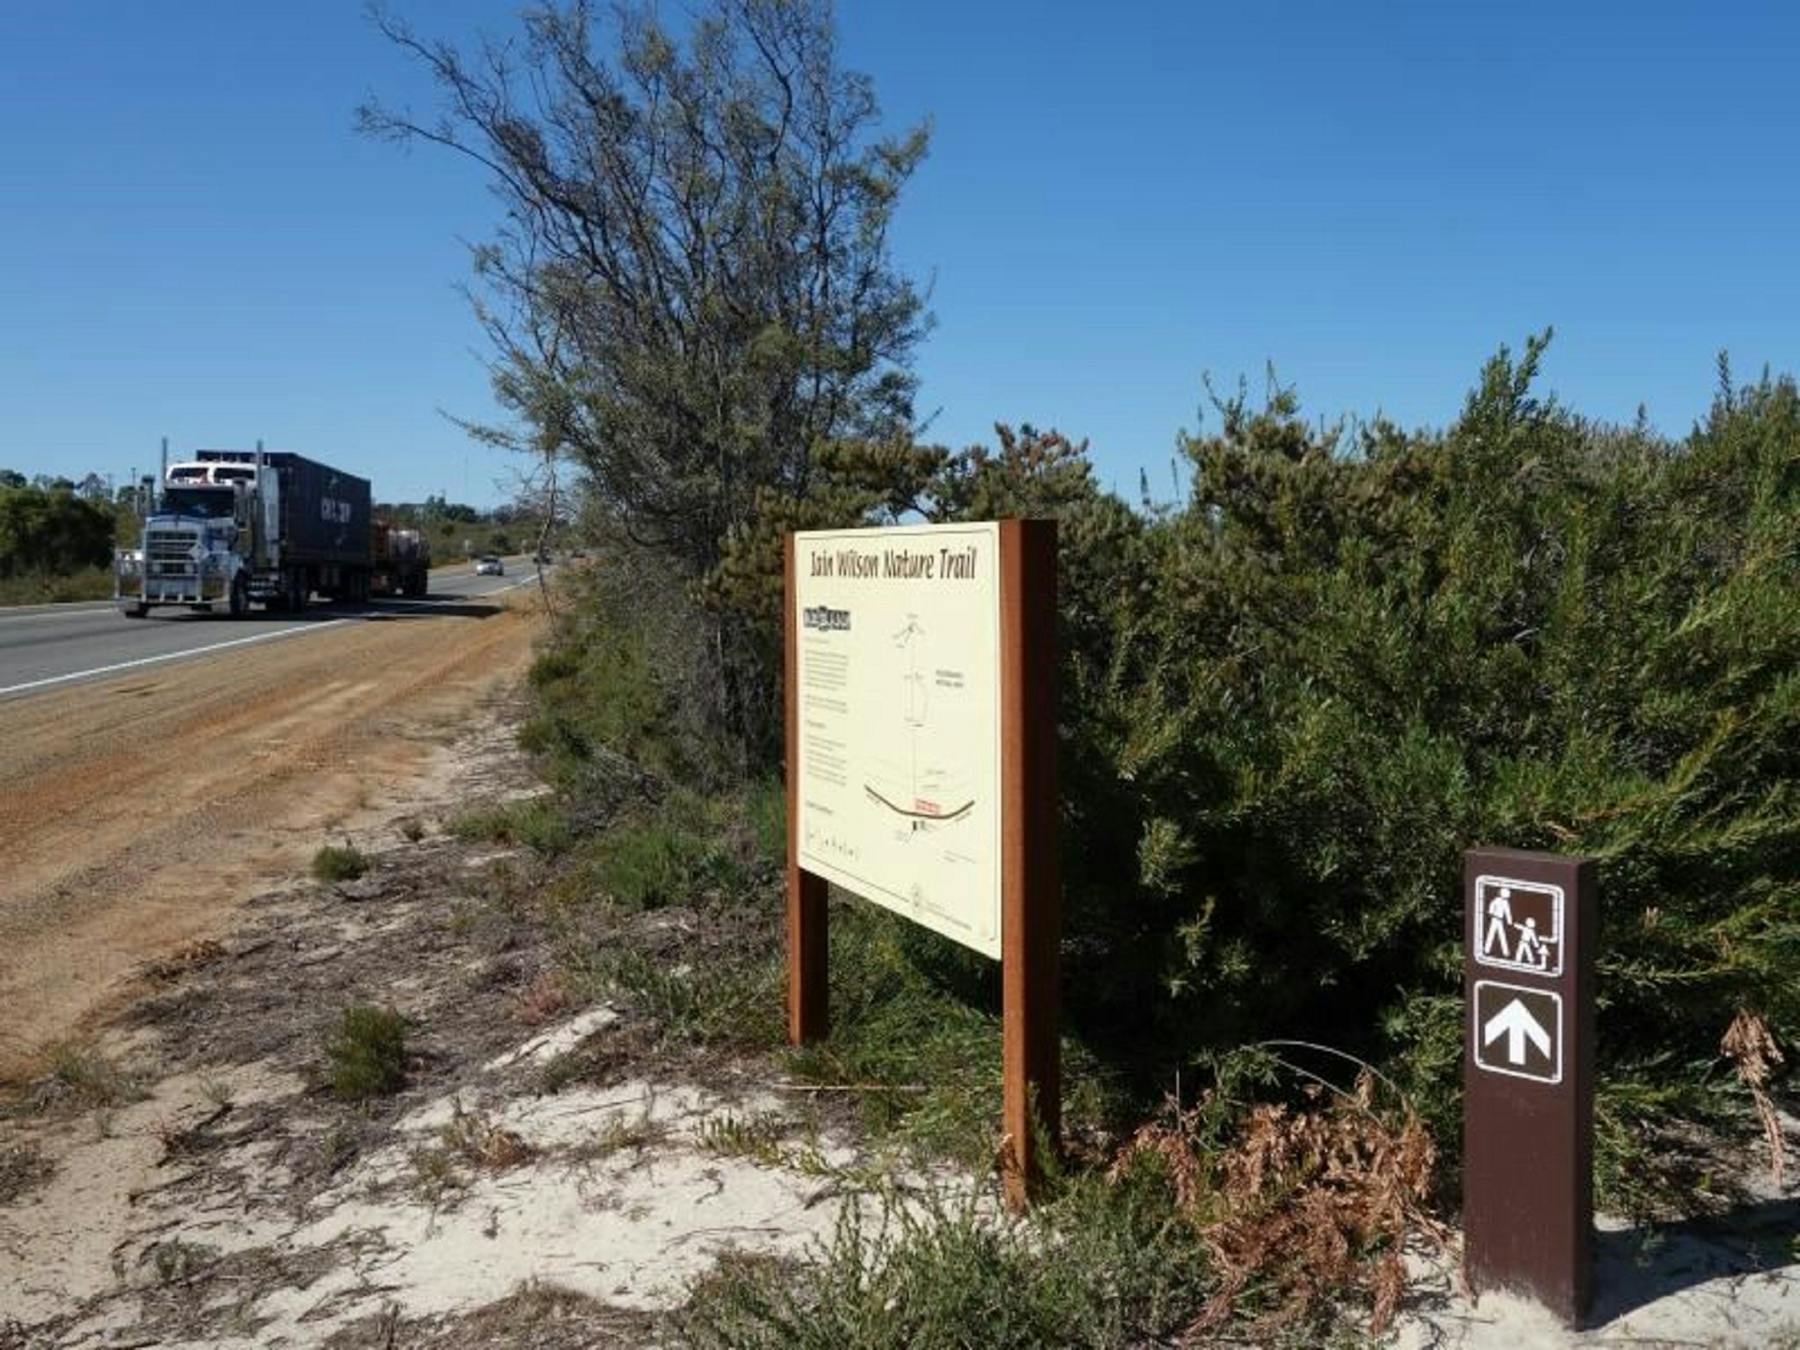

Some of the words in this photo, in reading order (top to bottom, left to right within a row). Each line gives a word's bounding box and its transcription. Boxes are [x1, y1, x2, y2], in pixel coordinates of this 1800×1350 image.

[810, 549, 833, 577] Iain
[836, 548, 879, 578] Wilson
[883, 548, 935, 579] Nature
[939, 546, 978, 579] Trail
